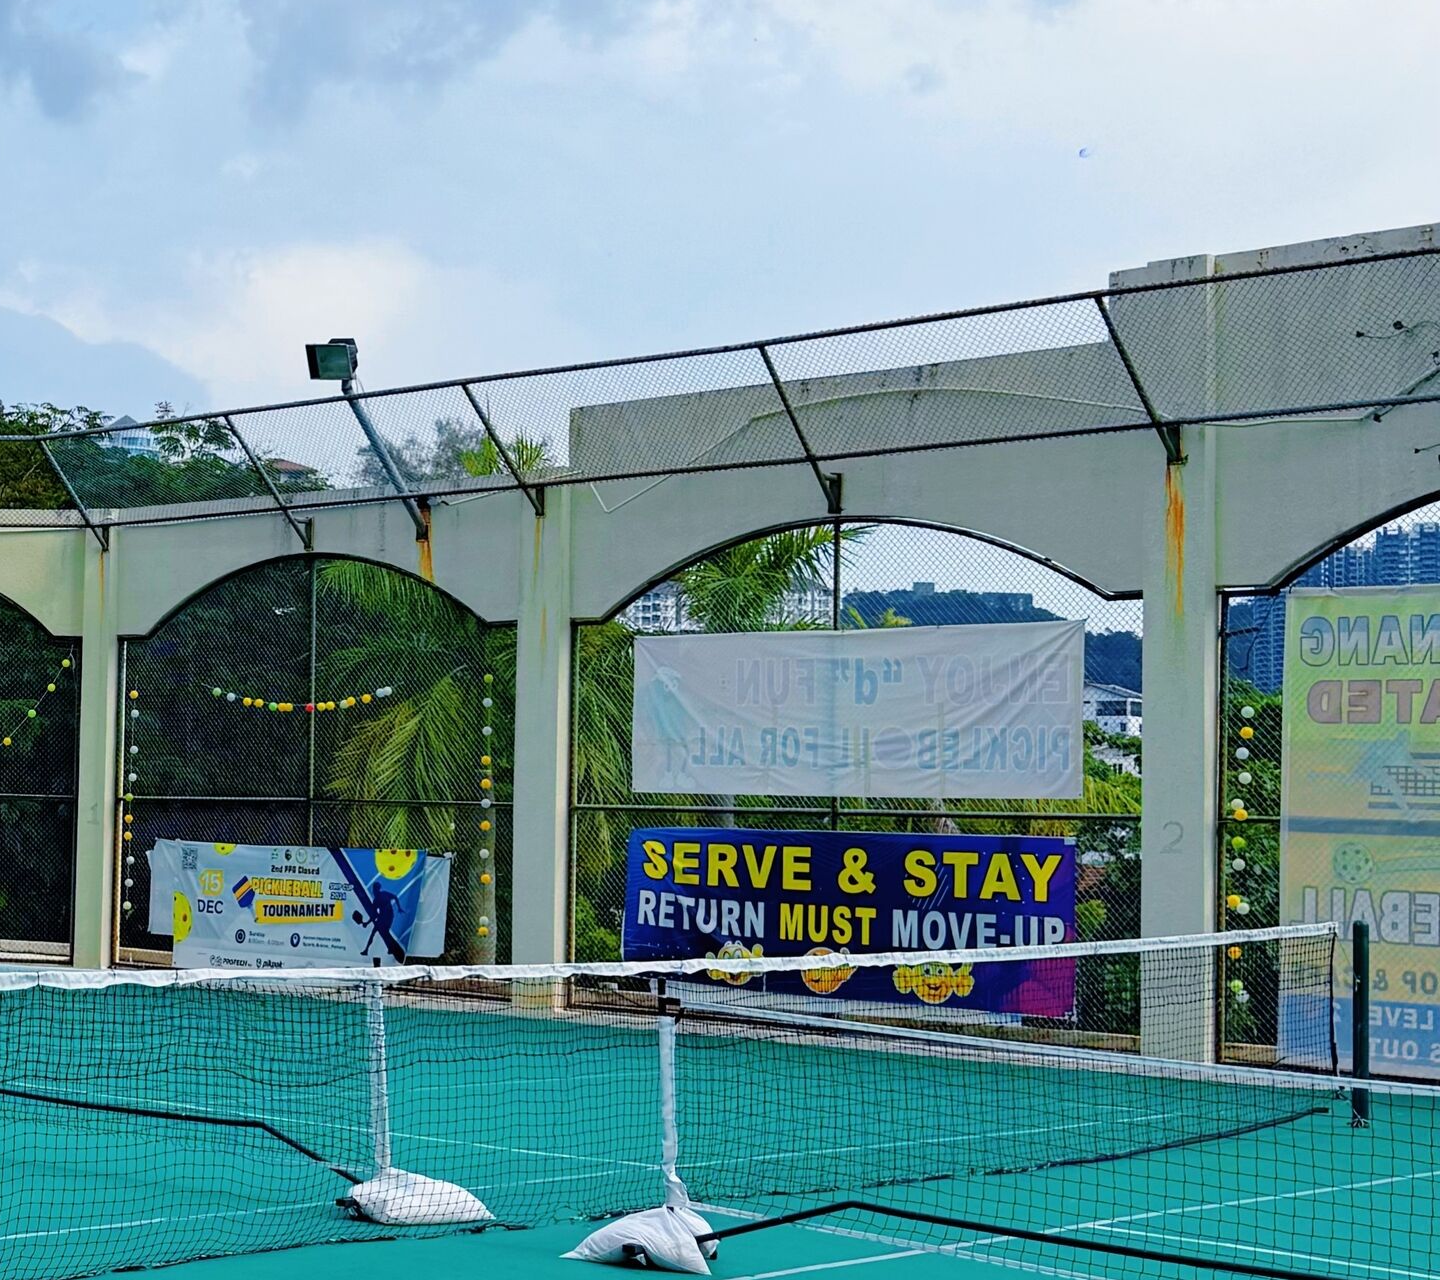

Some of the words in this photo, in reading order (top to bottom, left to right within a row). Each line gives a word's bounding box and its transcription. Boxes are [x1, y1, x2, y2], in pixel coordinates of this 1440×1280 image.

[200, 870, 223, 895] 15
[642, 840, 812, 891] SERVE
[837, 847, 877, 895] &
[903, 849, 1062, 902] STAY
[251, 877, 324, 898] PICKLEBALL
[197, 899, 224, 914] DEC
[262, 904, 336, 917] TOURNAMENT
[637, 889, 765, 939] RETURN
[779, 903, 877, 945] MUST
[892, 909, 1065, 950] MOVE-UP
